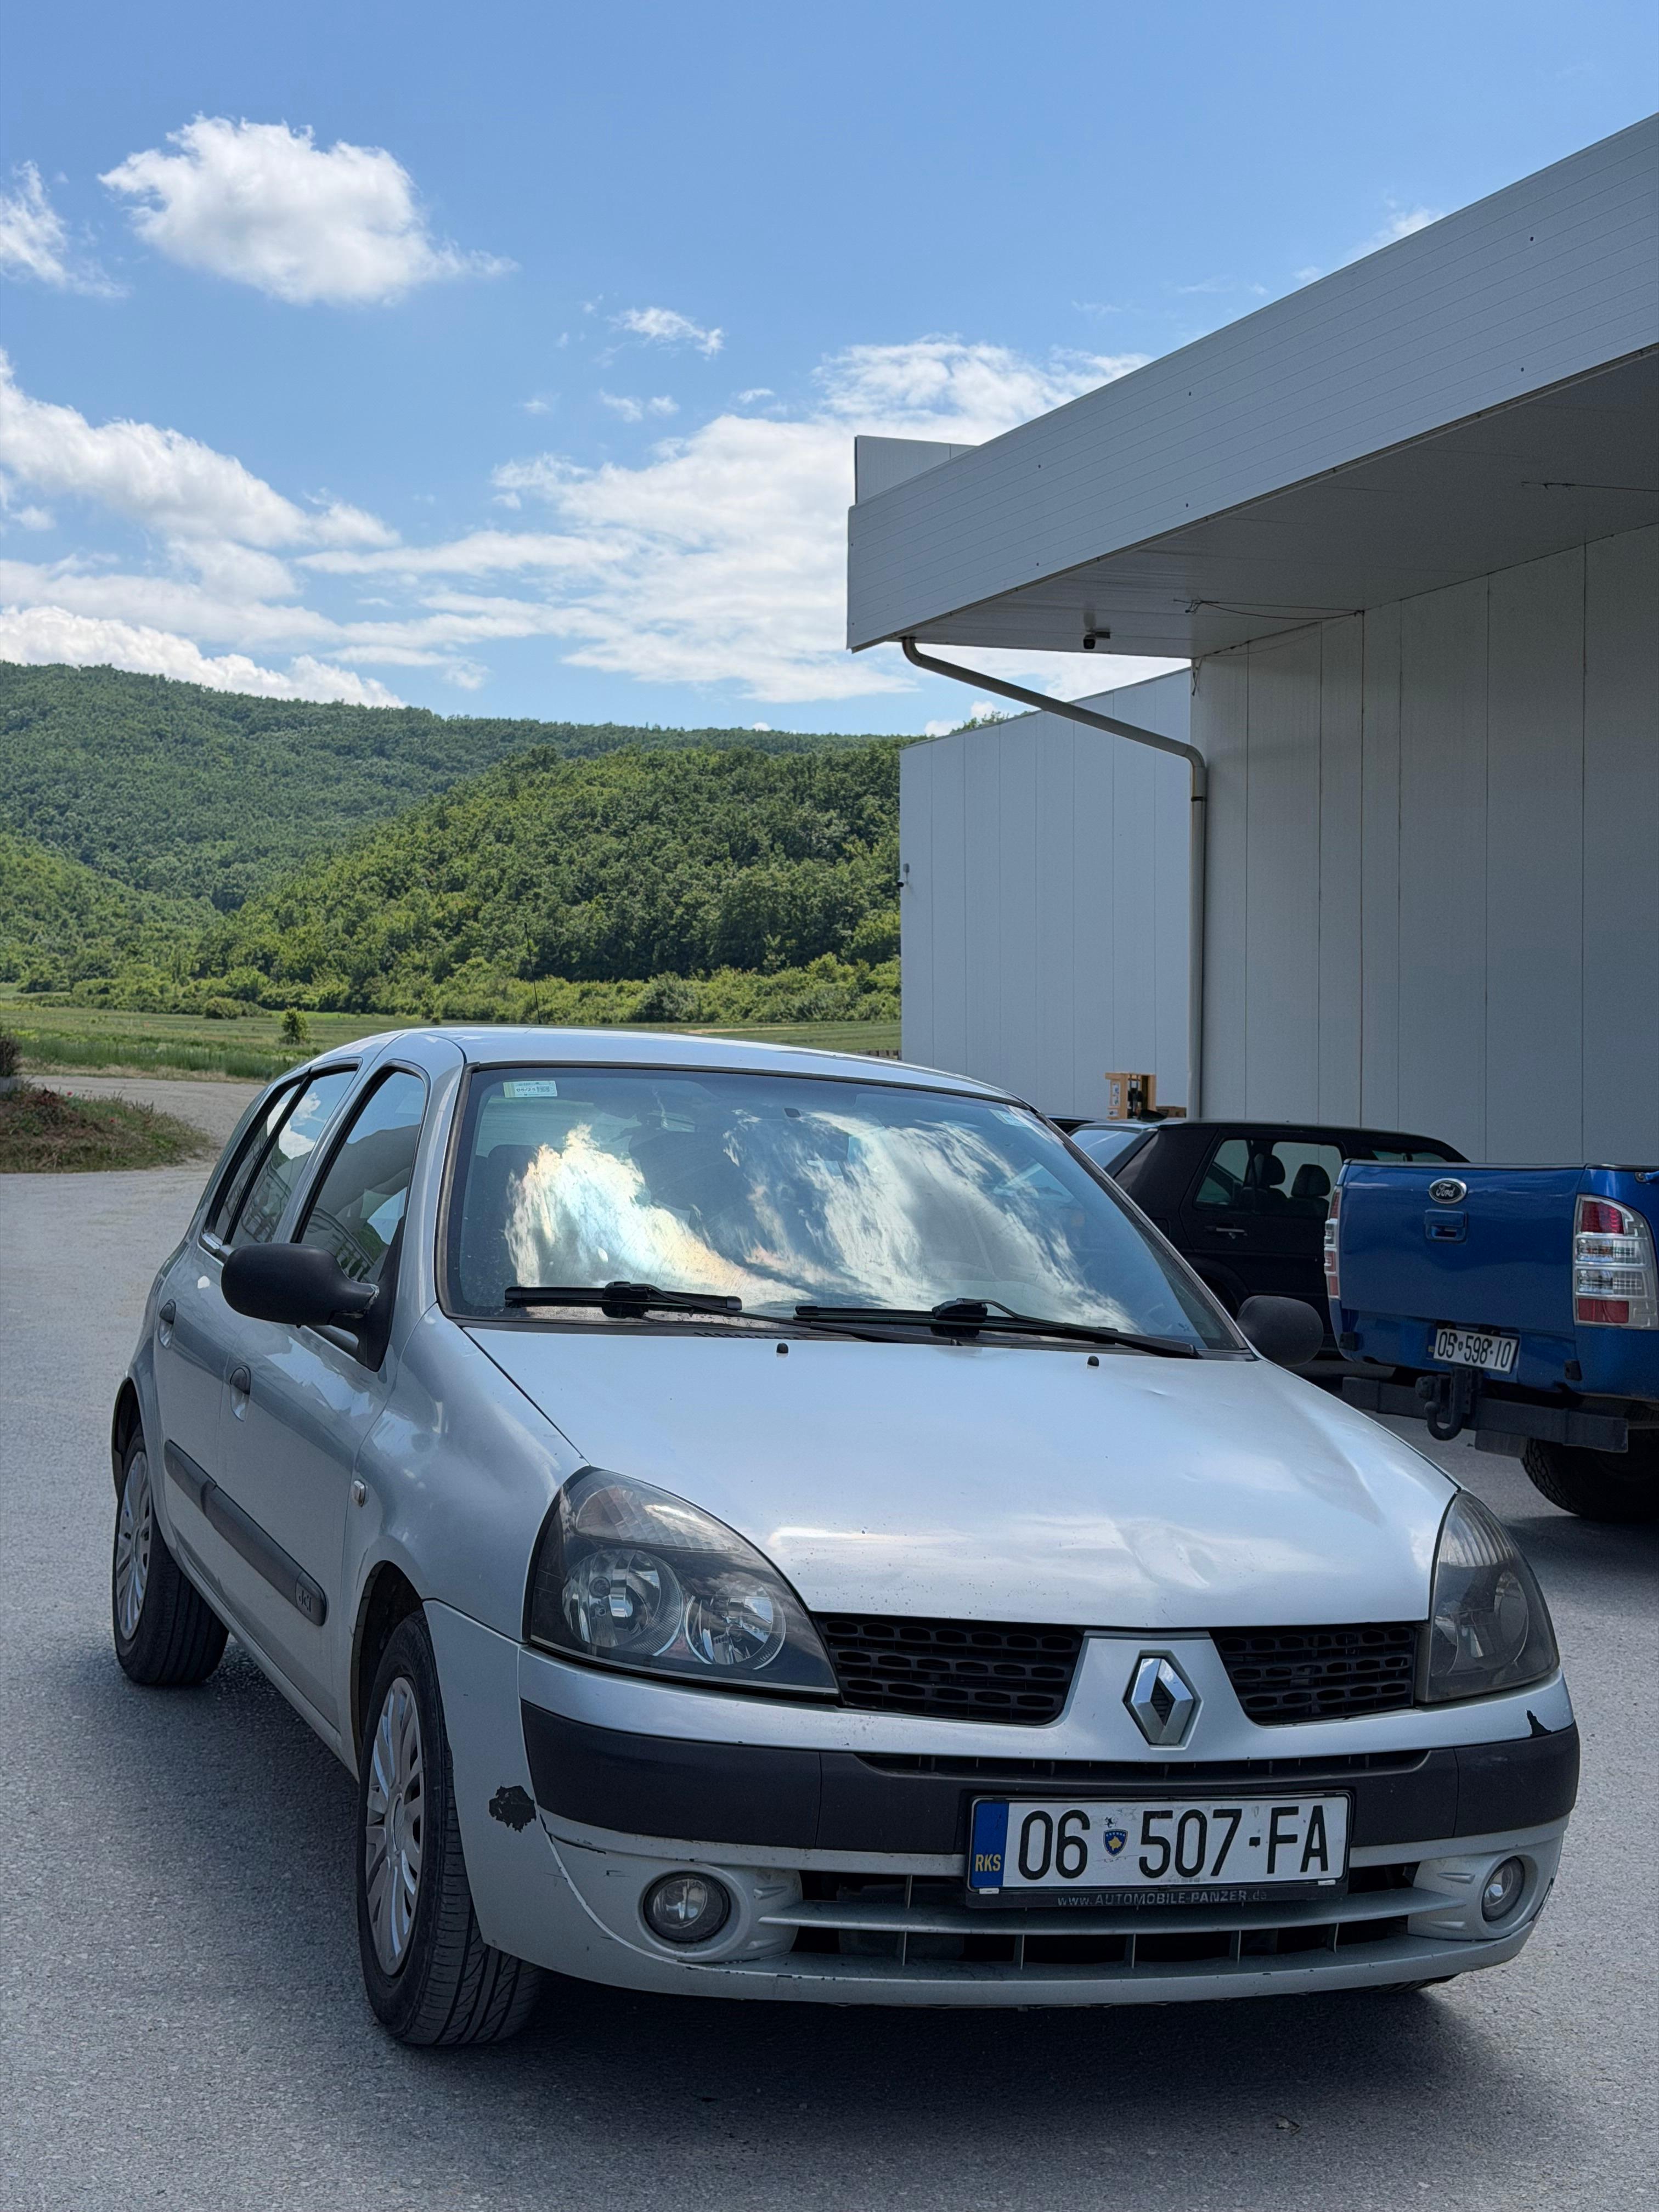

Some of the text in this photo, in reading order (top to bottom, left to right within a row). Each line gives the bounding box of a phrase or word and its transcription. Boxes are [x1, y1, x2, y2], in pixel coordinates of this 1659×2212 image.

[1436, 1183, 1455, 1197] Ford
[1437, 1331, 1457, 1358] 05
[1018, 1809, 1090, 1881] 06
[975, 1854, 1001, 1872] RKS
